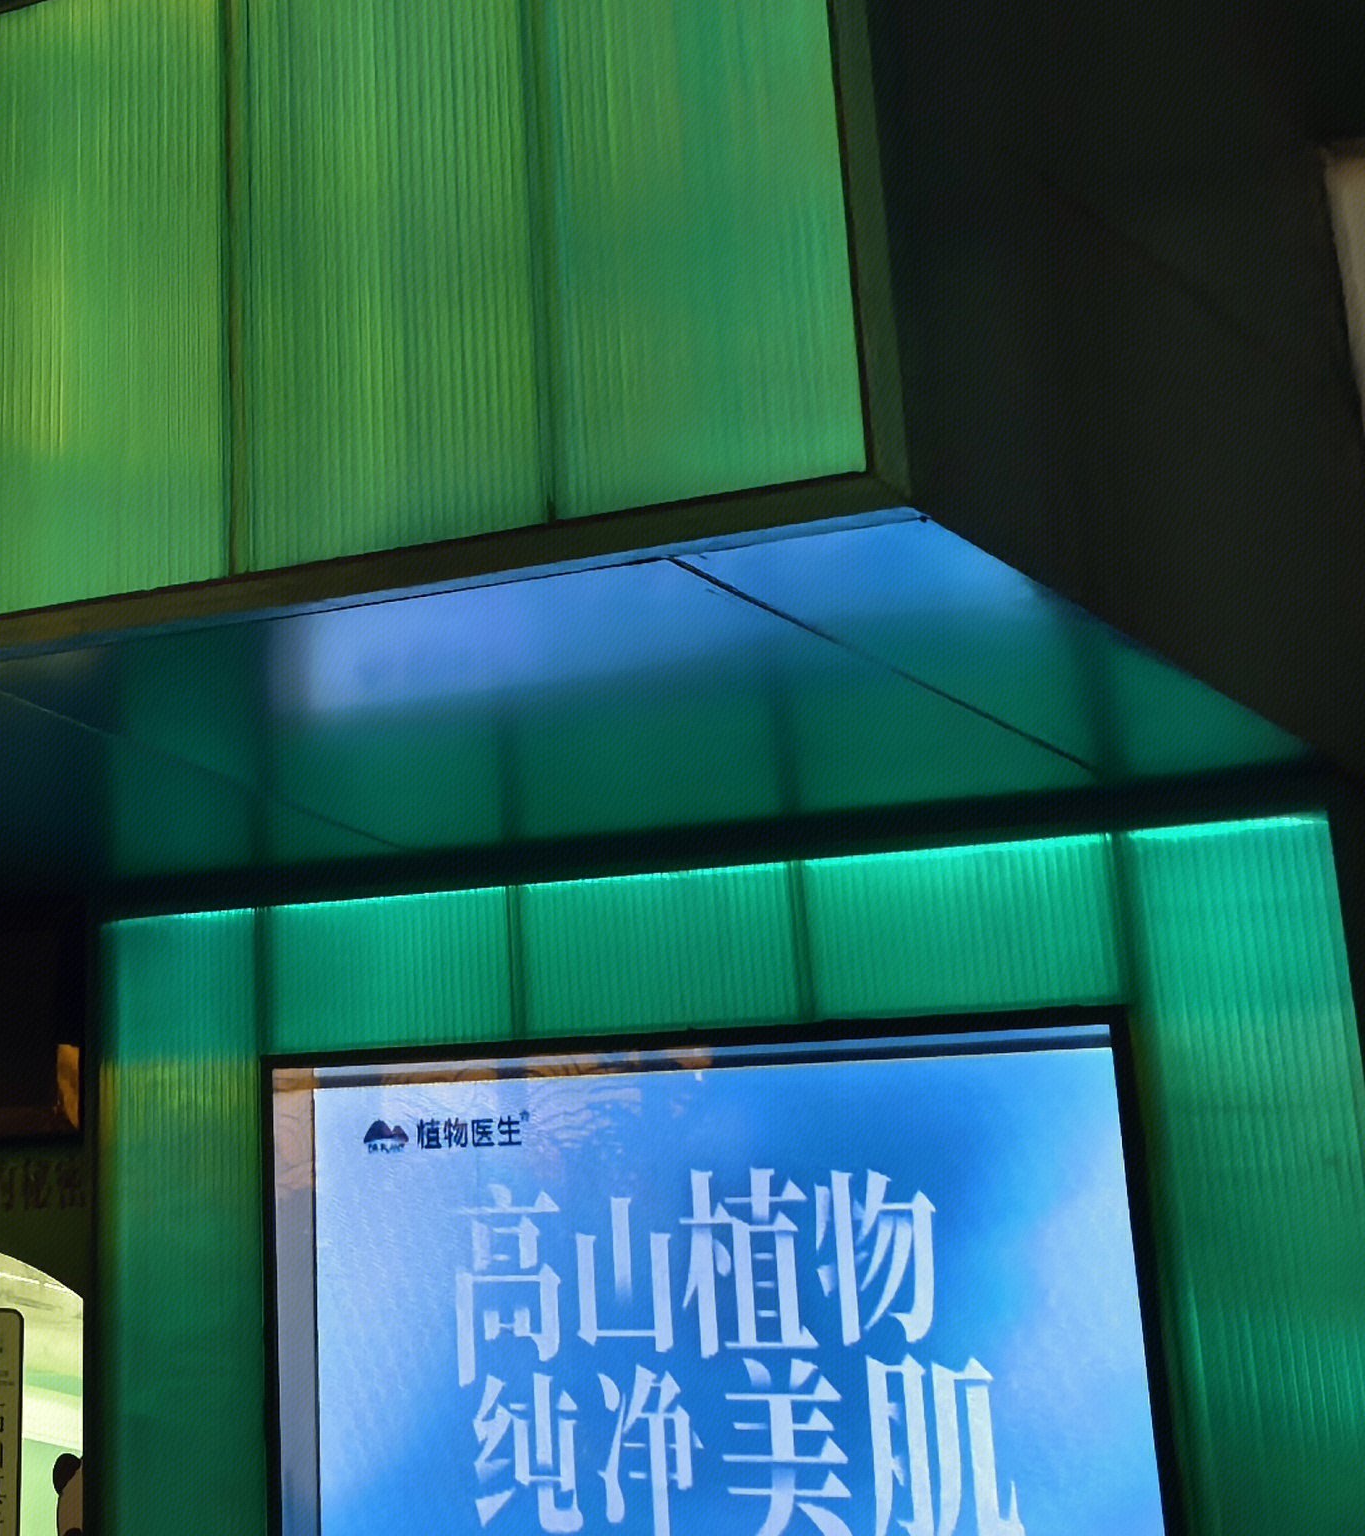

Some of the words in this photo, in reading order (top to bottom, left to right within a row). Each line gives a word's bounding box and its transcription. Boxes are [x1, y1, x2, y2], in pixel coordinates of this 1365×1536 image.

[416, 1114, 522, 1150] 植物医生
[453, 1166, 937, 1388] 高山植物
[473, 1353, 1026, 1536] 纯净美肌
